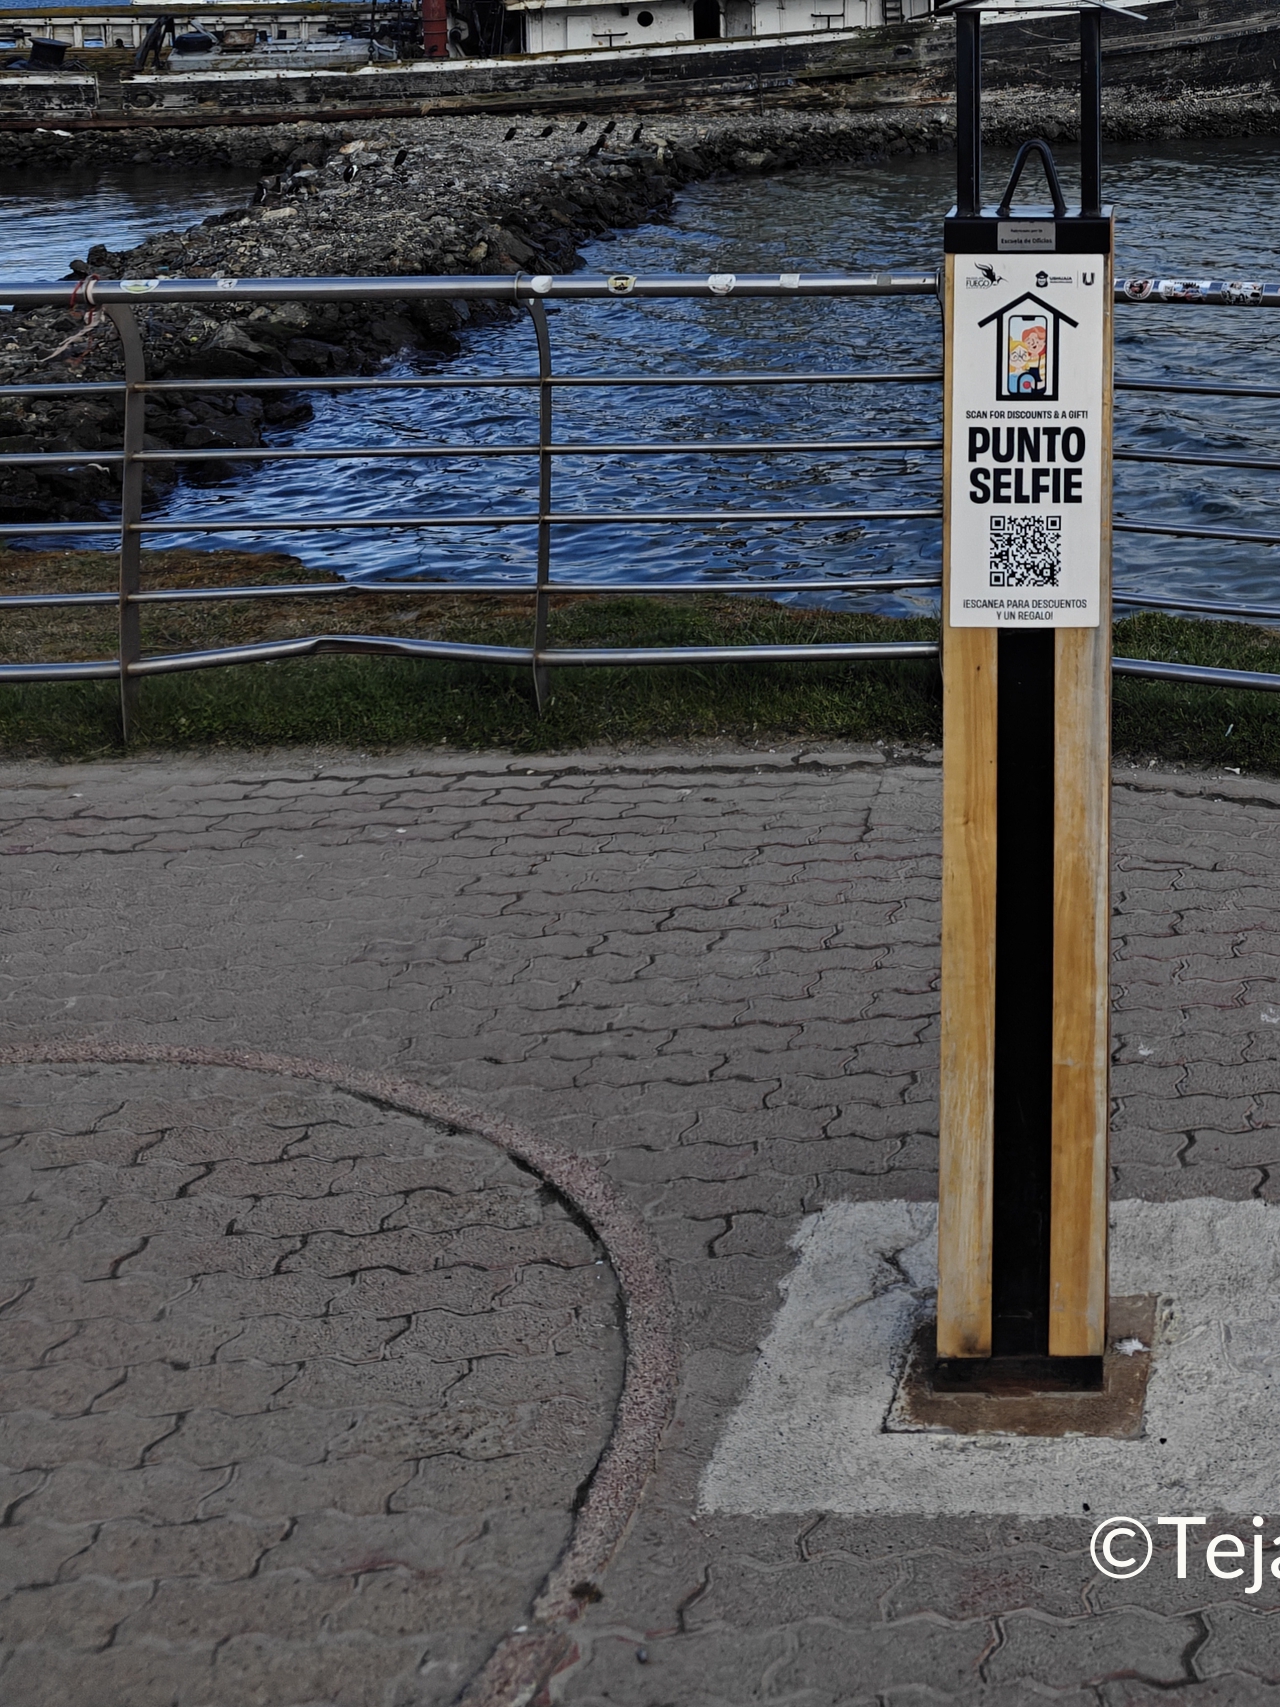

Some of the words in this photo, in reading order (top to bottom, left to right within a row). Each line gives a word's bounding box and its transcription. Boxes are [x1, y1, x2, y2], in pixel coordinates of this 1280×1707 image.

[966, 279, 990, 287] FUEGO
[966, 410, 987, 419] SCAN
[990, 410, 1005, 419] FOR
[1007, 410, 1052, 419] DISCOUNTS
[1054, 410, 1059, 419] &
[1061, 410, 1067, 419] A
[1069, 410, 1088, 419] GIFT!
[968, 426, 1086, 463] PUNTO
[969, 467, 1082, 504] SELFIE
[1006, 599, 1030, 609] PARA
[1031, 599, 1087, 609] DESCUENTOS
[996, 611, 1002, 621] Y
[1003, 611, 1016, 621] UN
[1018, 611, 1053, 621] REGALO!
